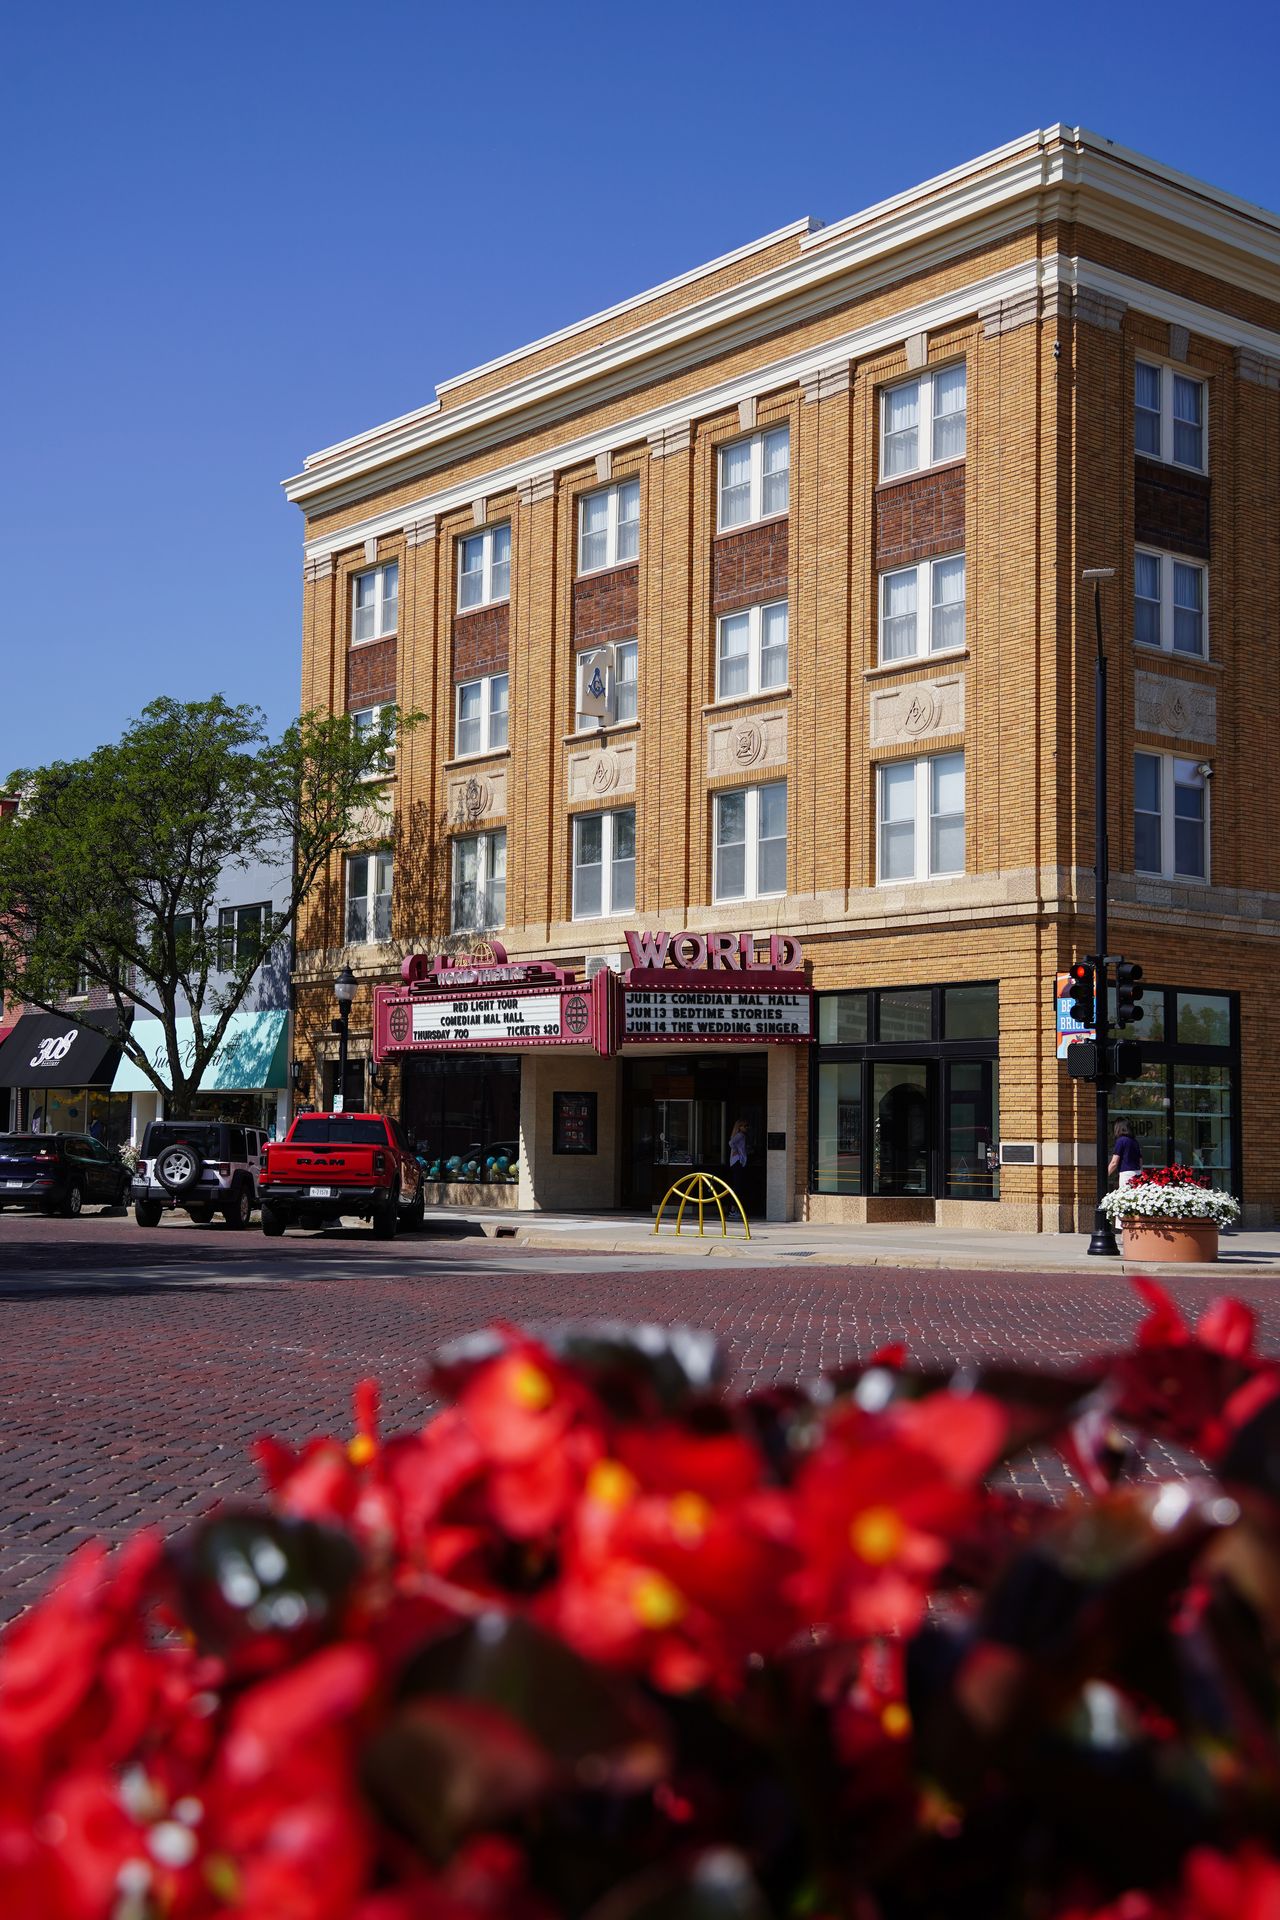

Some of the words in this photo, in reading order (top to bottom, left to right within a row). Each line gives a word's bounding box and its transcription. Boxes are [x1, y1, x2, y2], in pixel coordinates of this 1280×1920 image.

[624, 930, 802, 972] WORLD
[436, 970, 478, 986] WORLD
[453, 1001, 469, 1013] RED
[470, 1000, 495, 1012] LIGHT
[498, 998, 518, 1010] TOUR
[626, 993, 651, 1004] JUN
[653, 993, 667, 1004] 12
[671, 993, 732, 1005] COMEDIAN
[738, 994, 764, 1005] MAL
[768, 994, 800, 1006] HALL
[440, 1014, 481, 1027] COMEDIAN
[483, 1013, 501, 1025] MAL
[503, 1012, 525, 1024] HALL
[626, 1007, 651, 1018] JUN
[653, 1007, 667, 1018] 13
[672, 1008, 725, 1019] BEDTIME
[731, 1008, 783, 1019] STORIES
[506, 1024, 541, 1036] TICKETS
[543, 1023, 560, 1035] $20
[626, 1021, 651, 1032] JUN
[654, 1021, 667, 1032] 14
[671, 1021, 694, 1033] THE
[697, 1022, 751, 1033] WEDDING
[756, 1022, 799, 1033] SINGER
[413, 1029, 450, 1041] THURSDAY
[453, 1028, 470, 1039] 700
[29, 1029, 79, 1067] 308
[296, 1158, 345, 1166] RAM
